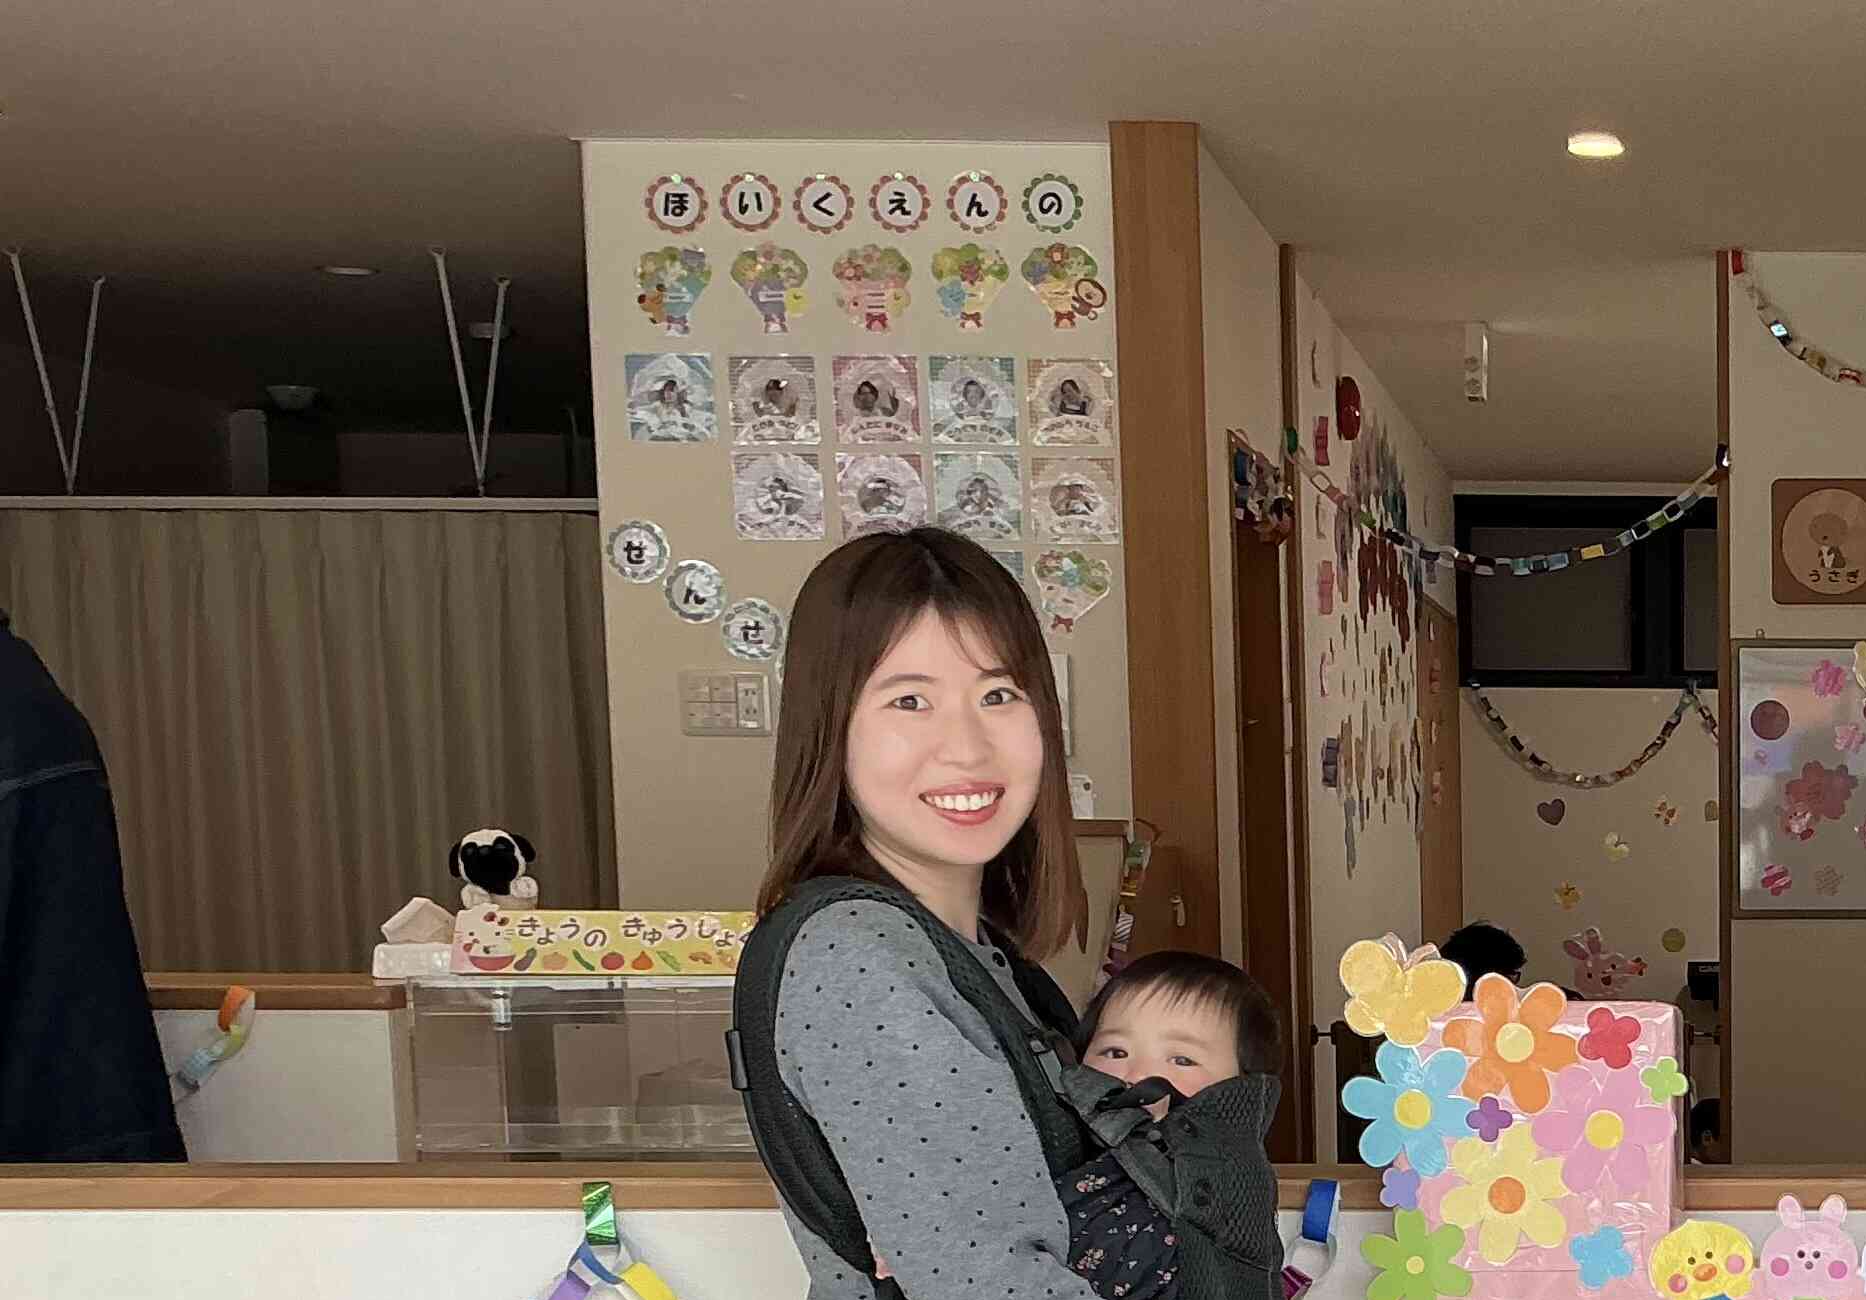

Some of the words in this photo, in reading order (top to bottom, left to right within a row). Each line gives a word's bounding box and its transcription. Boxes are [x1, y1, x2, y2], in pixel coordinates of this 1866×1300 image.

[663, 191, 1064, 218] ほいくえんの
[1808, 569, 1860, 584] うさぎ
[517, 916, 608, 947] きょうの
